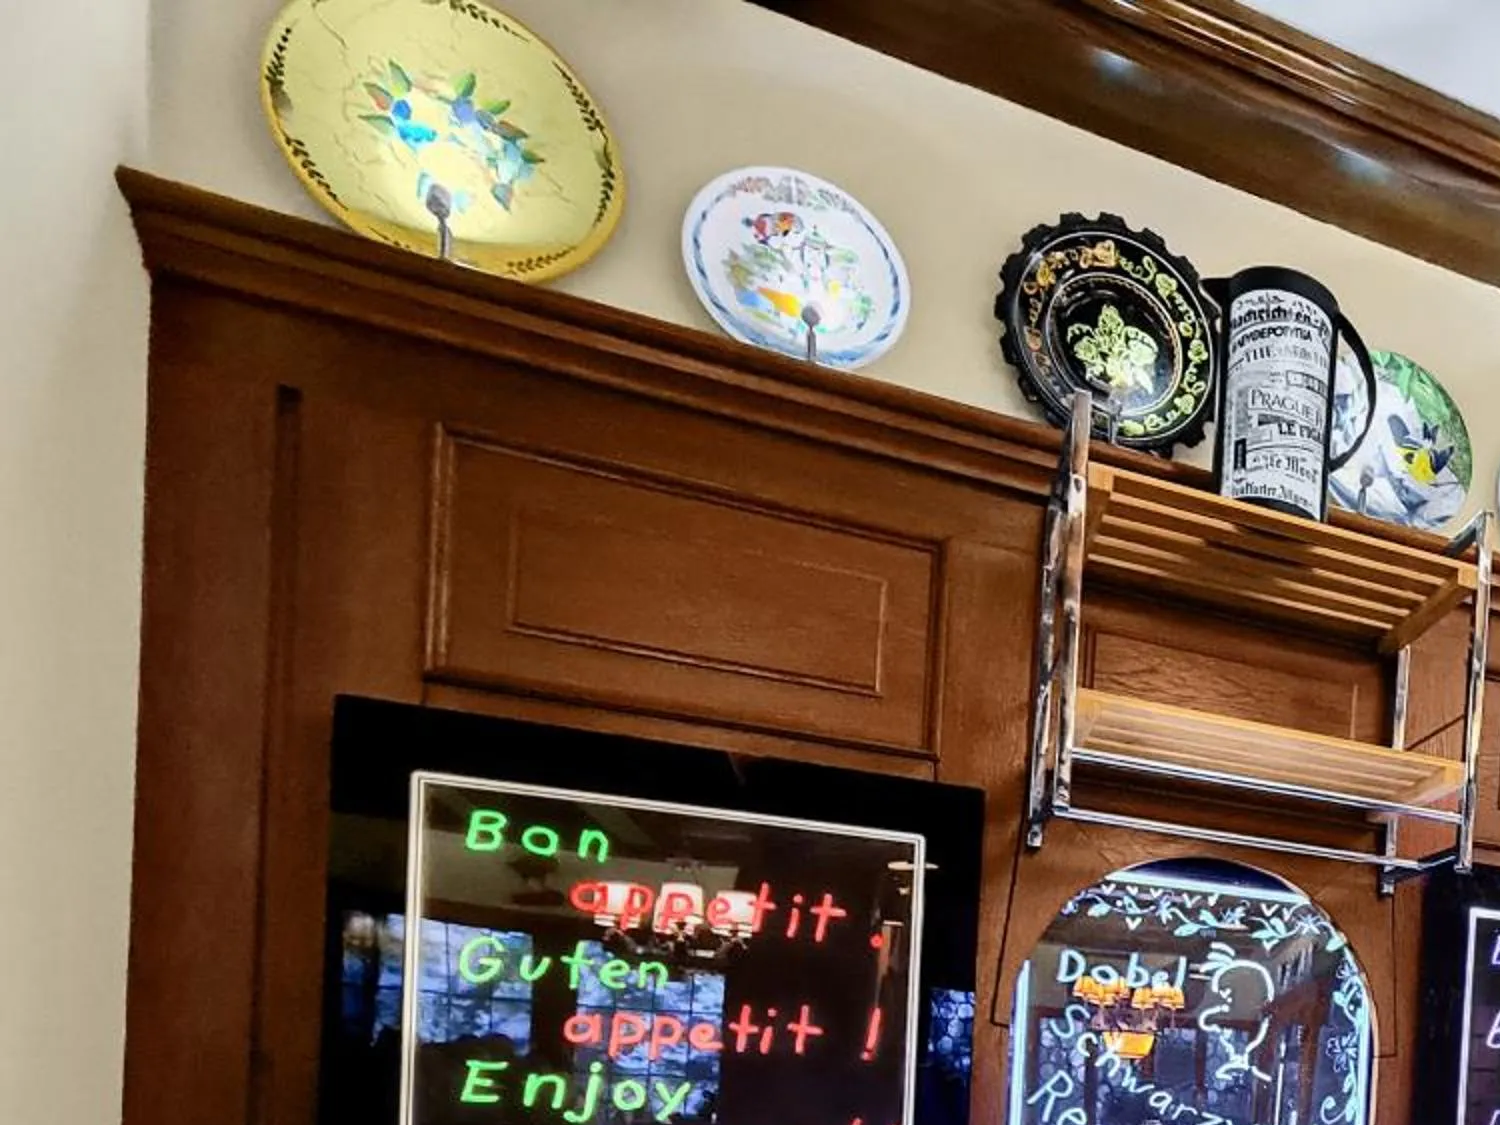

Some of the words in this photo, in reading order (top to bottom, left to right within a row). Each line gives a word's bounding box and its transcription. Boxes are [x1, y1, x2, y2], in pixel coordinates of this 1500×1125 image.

[1250, 388, 1315, 419] PRAGUE
[464, 810, 611, 864] Bon
[569, 880, 847, 942] appetit
[457, 935, 669, 990] Guten
[1056, 948, 1189, 990] Dobel
[563, 1004, 824, 1060] appetit
[460, 1057, 692, 1124] Enjoy
